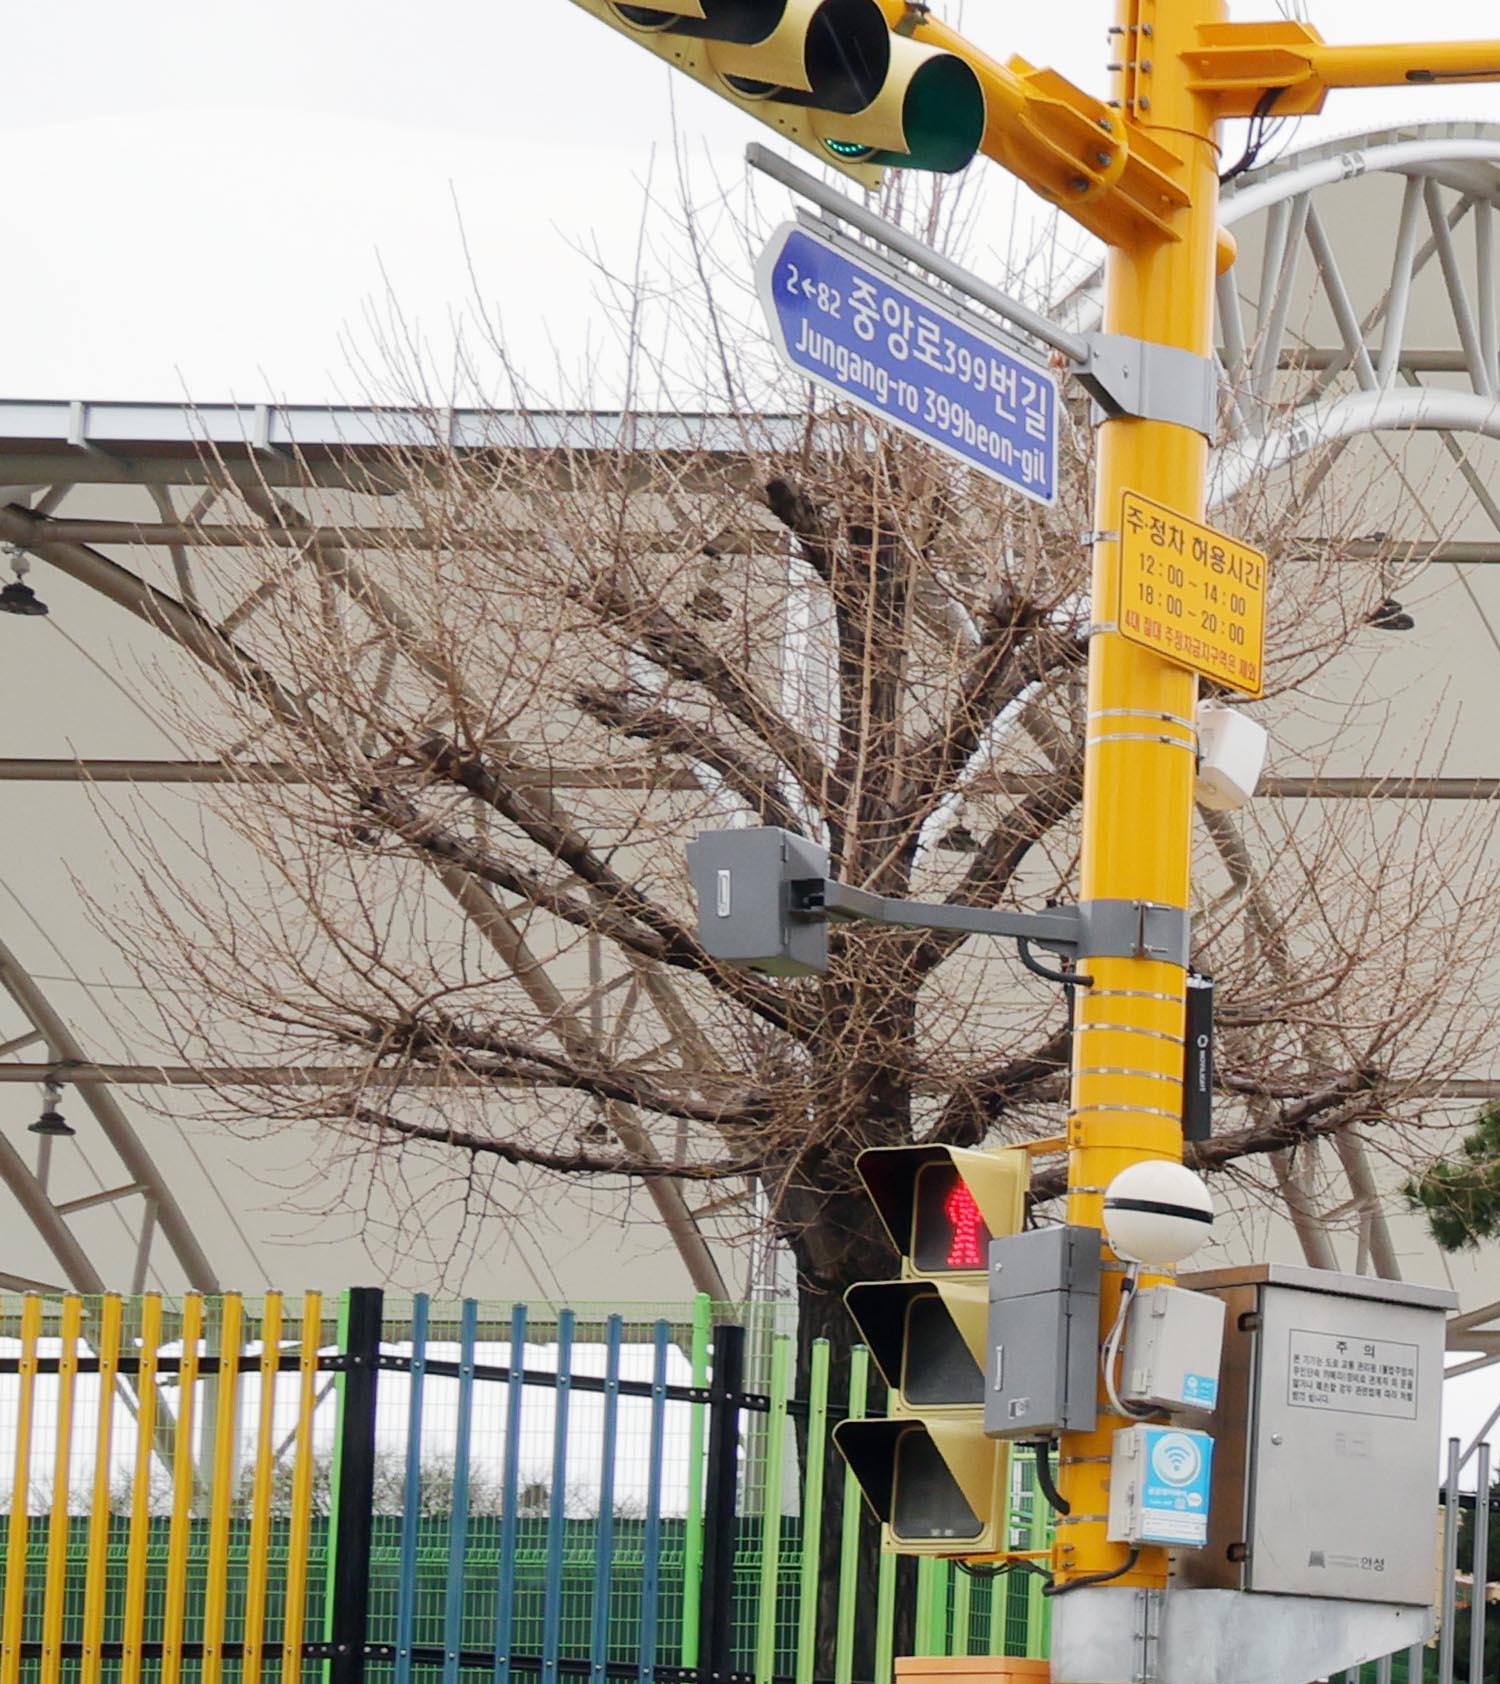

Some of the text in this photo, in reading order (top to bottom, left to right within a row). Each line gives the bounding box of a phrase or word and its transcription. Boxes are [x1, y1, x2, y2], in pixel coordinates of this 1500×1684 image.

[795, 318, 1046, 484] Jungang-ro 399beon-gil
[848, 276, 1046, 442] 중앙로399번길
[1192, 536, 1260, 591] 허용시간
